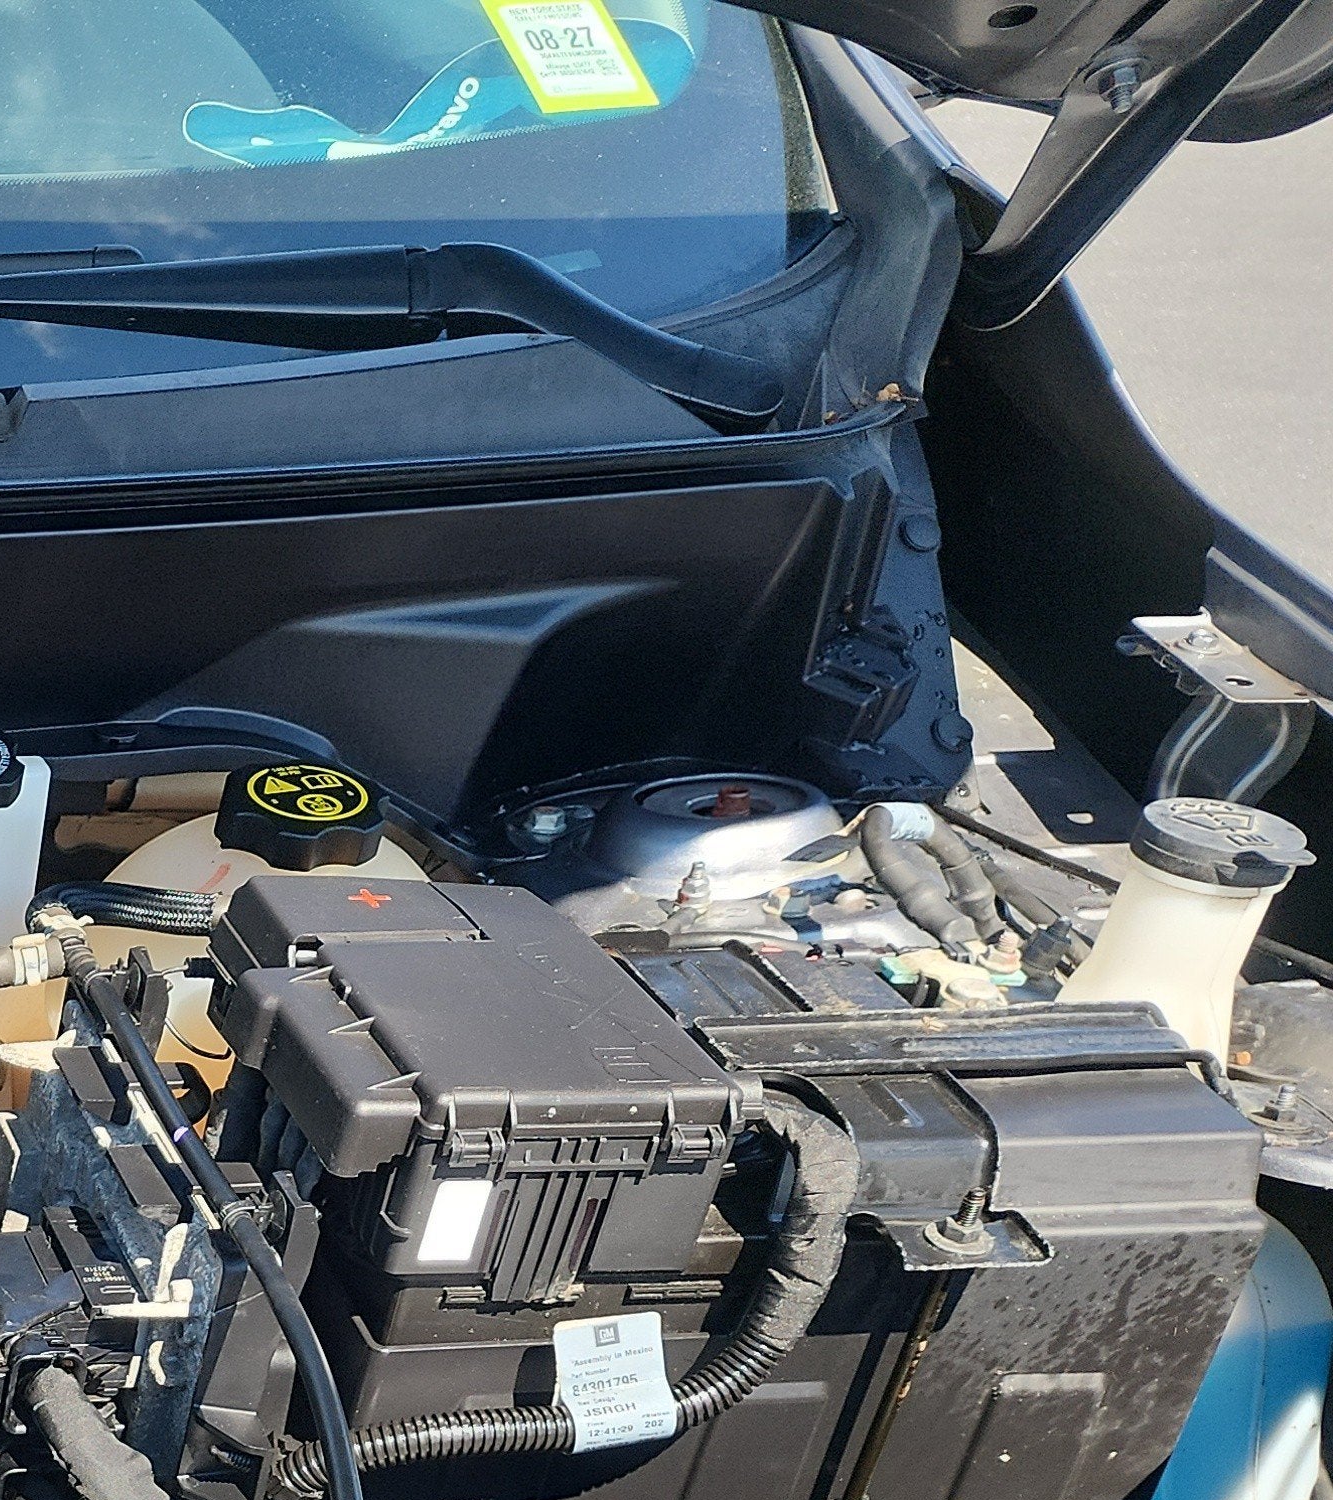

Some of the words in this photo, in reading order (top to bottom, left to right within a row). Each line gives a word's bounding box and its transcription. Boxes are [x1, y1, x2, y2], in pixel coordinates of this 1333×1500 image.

[625, 1346, 653, 1356] Mexico
[585, 1368, 609, 1376] Number
[644, 1419, 664, 1429] 202
